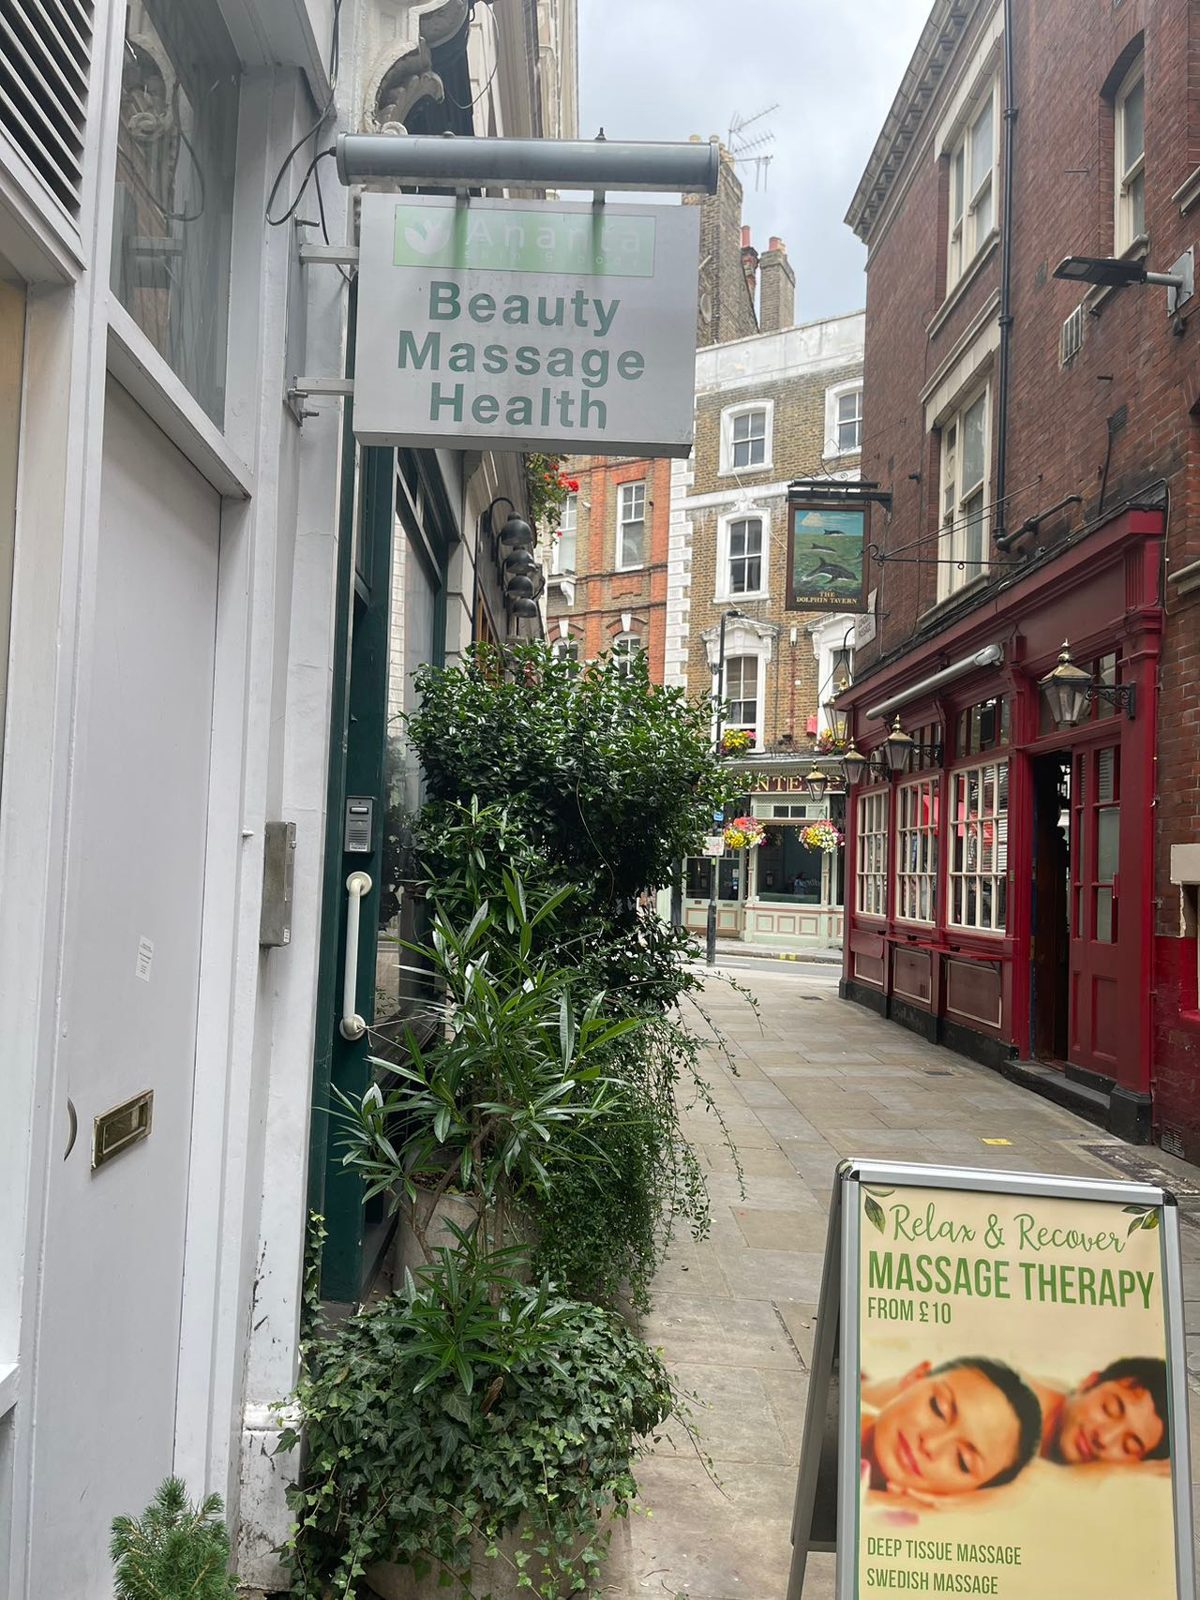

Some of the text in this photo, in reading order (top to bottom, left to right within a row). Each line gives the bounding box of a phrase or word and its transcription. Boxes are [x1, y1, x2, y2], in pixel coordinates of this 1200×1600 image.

[428, 280, 621, 337] Beauty
[397, 330, 645, 388] Massage
[429, 382, 608, 430] Health
[796, 596, 858, 606] DOLPHIN TAVERN
[889, 1202, 1126, 1253] Relax & Recover
[868, 1250, 1155, 1309] MASSAGE THERAPY
[868, 1297, 952, 1324] FROM £10
[867, 1537, 1022, 1565] DEEP TISSUE MASSAGE
[866, 1567, 999, 1595] SWEDISH MASSAGE
